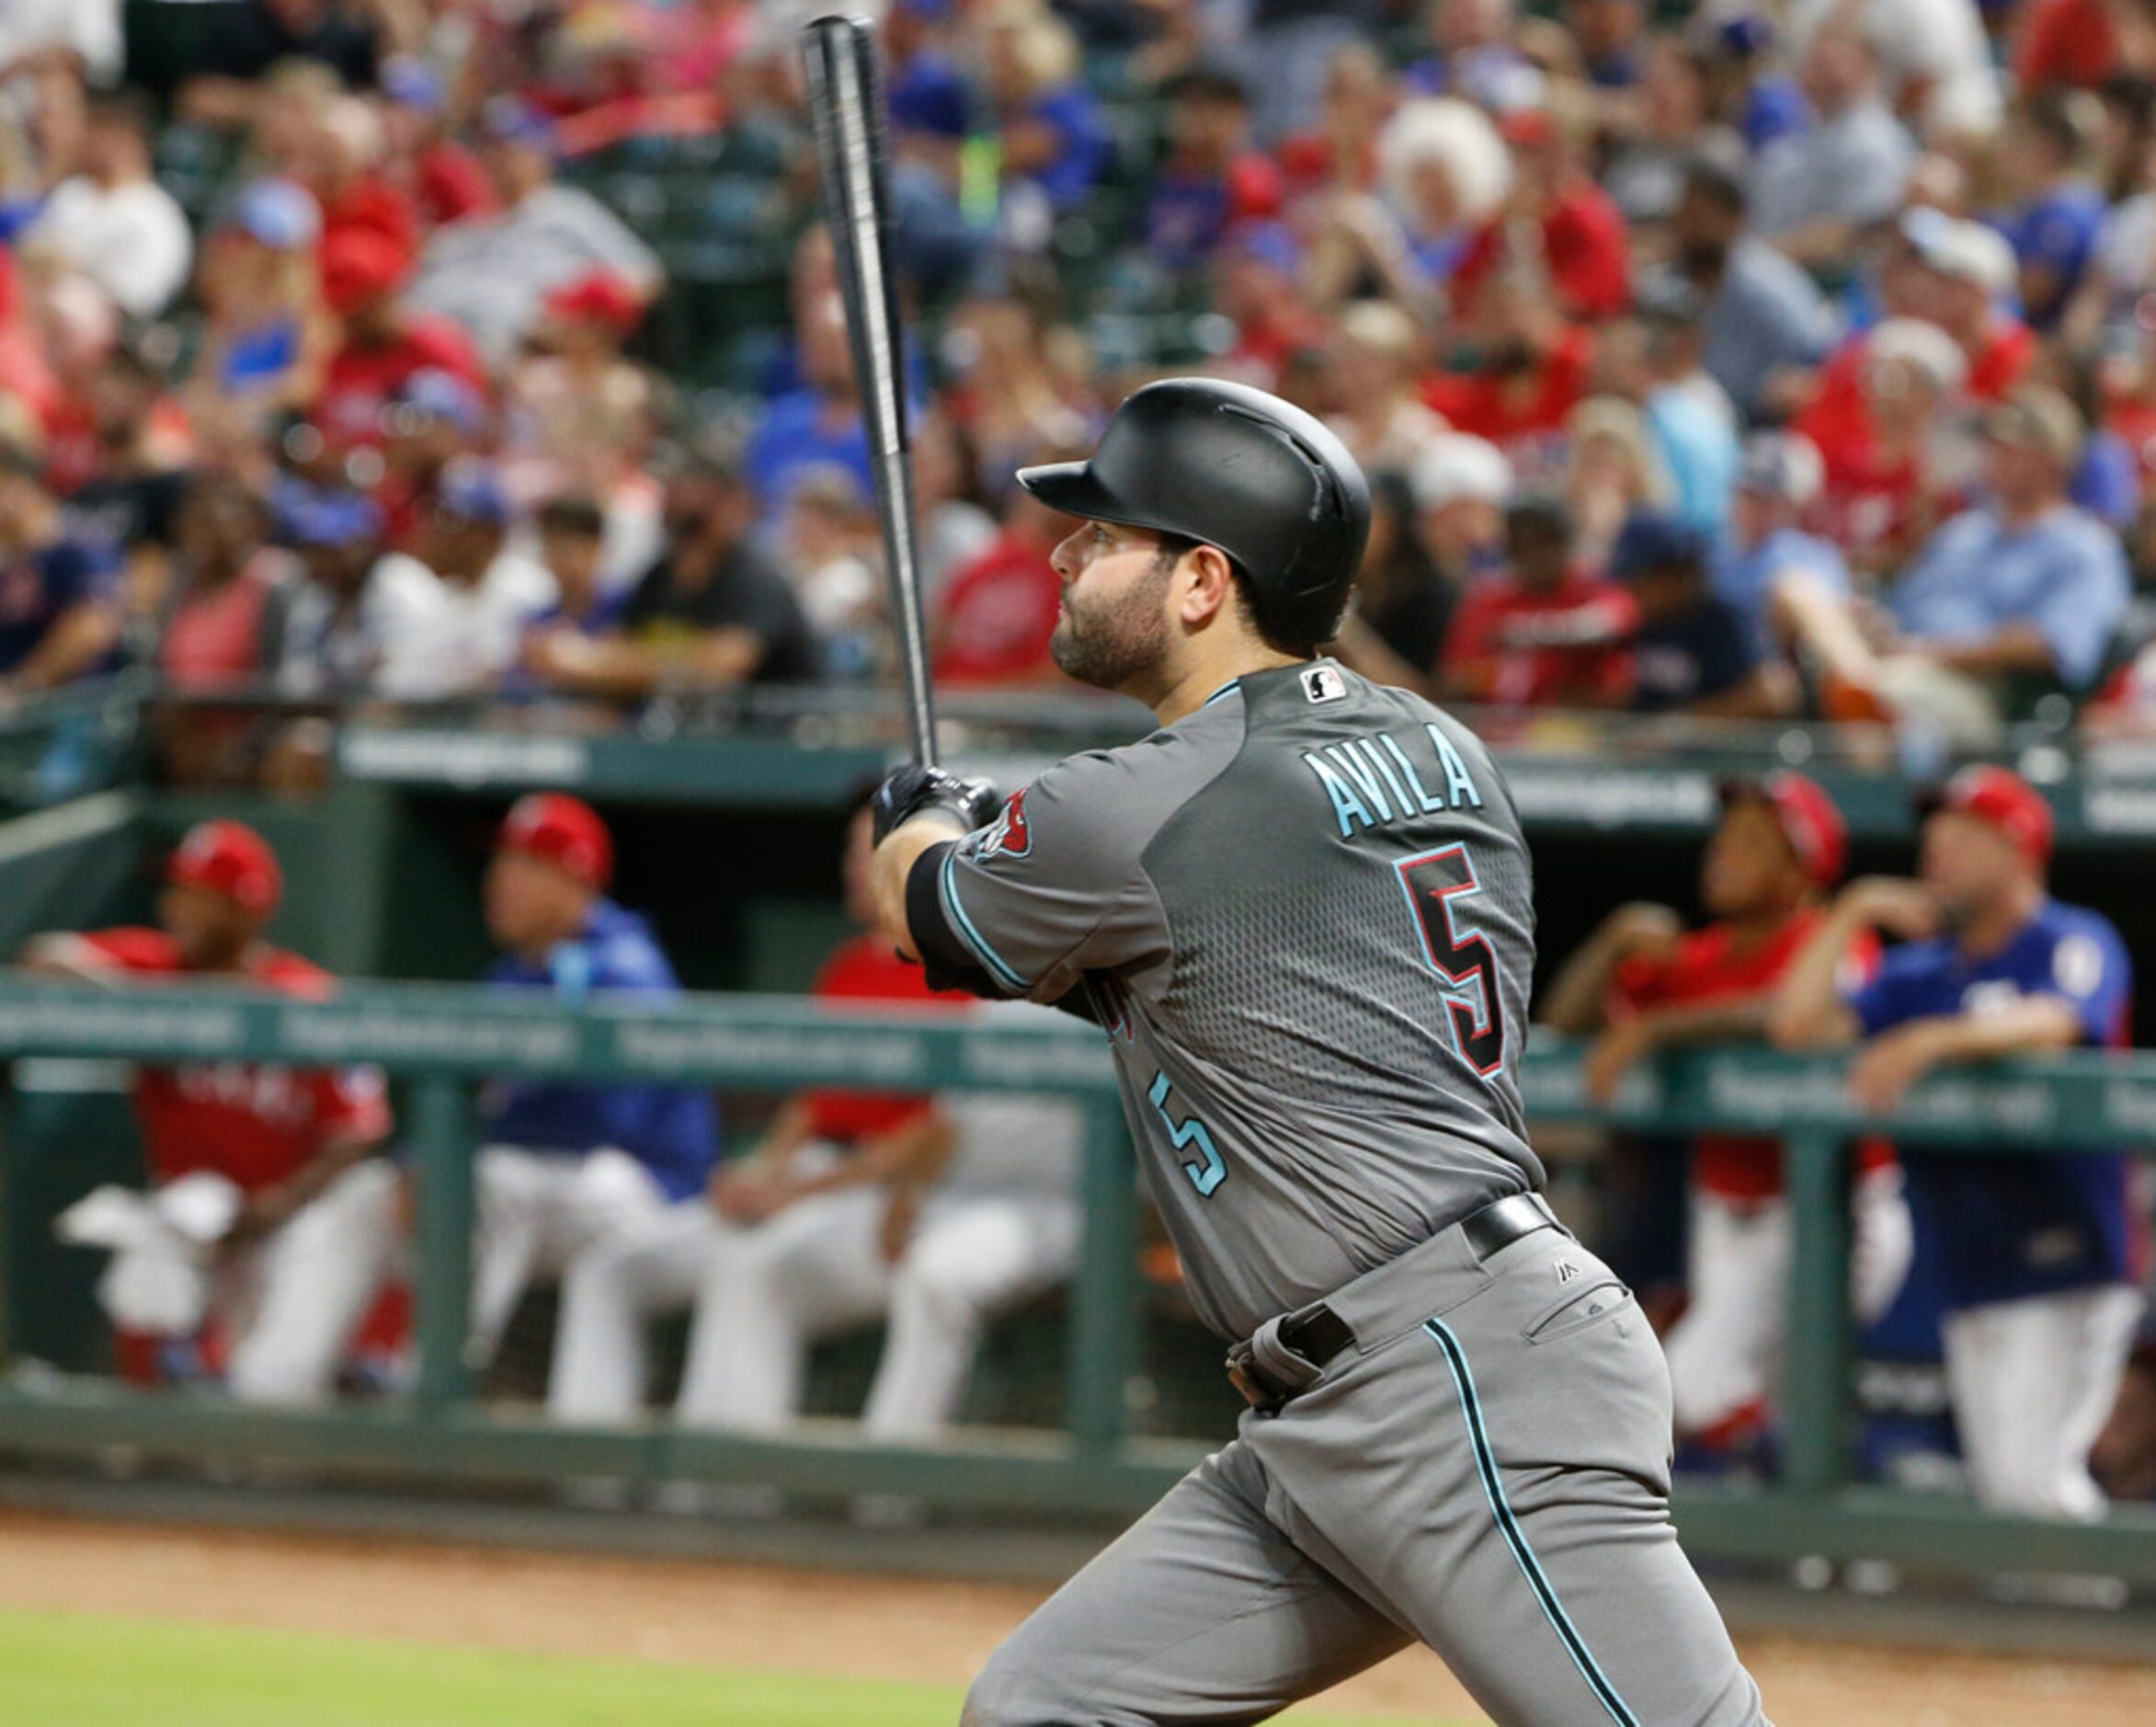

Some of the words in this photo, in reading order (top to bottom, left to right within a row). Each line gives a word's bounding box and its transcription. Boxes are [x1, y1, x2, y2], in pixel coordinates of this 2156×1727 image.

[1302, 722, 1483, 839] AVILA
[1392, 841, 1505, 1082] 5
[1147, 1069, 1228, 1198] 5
